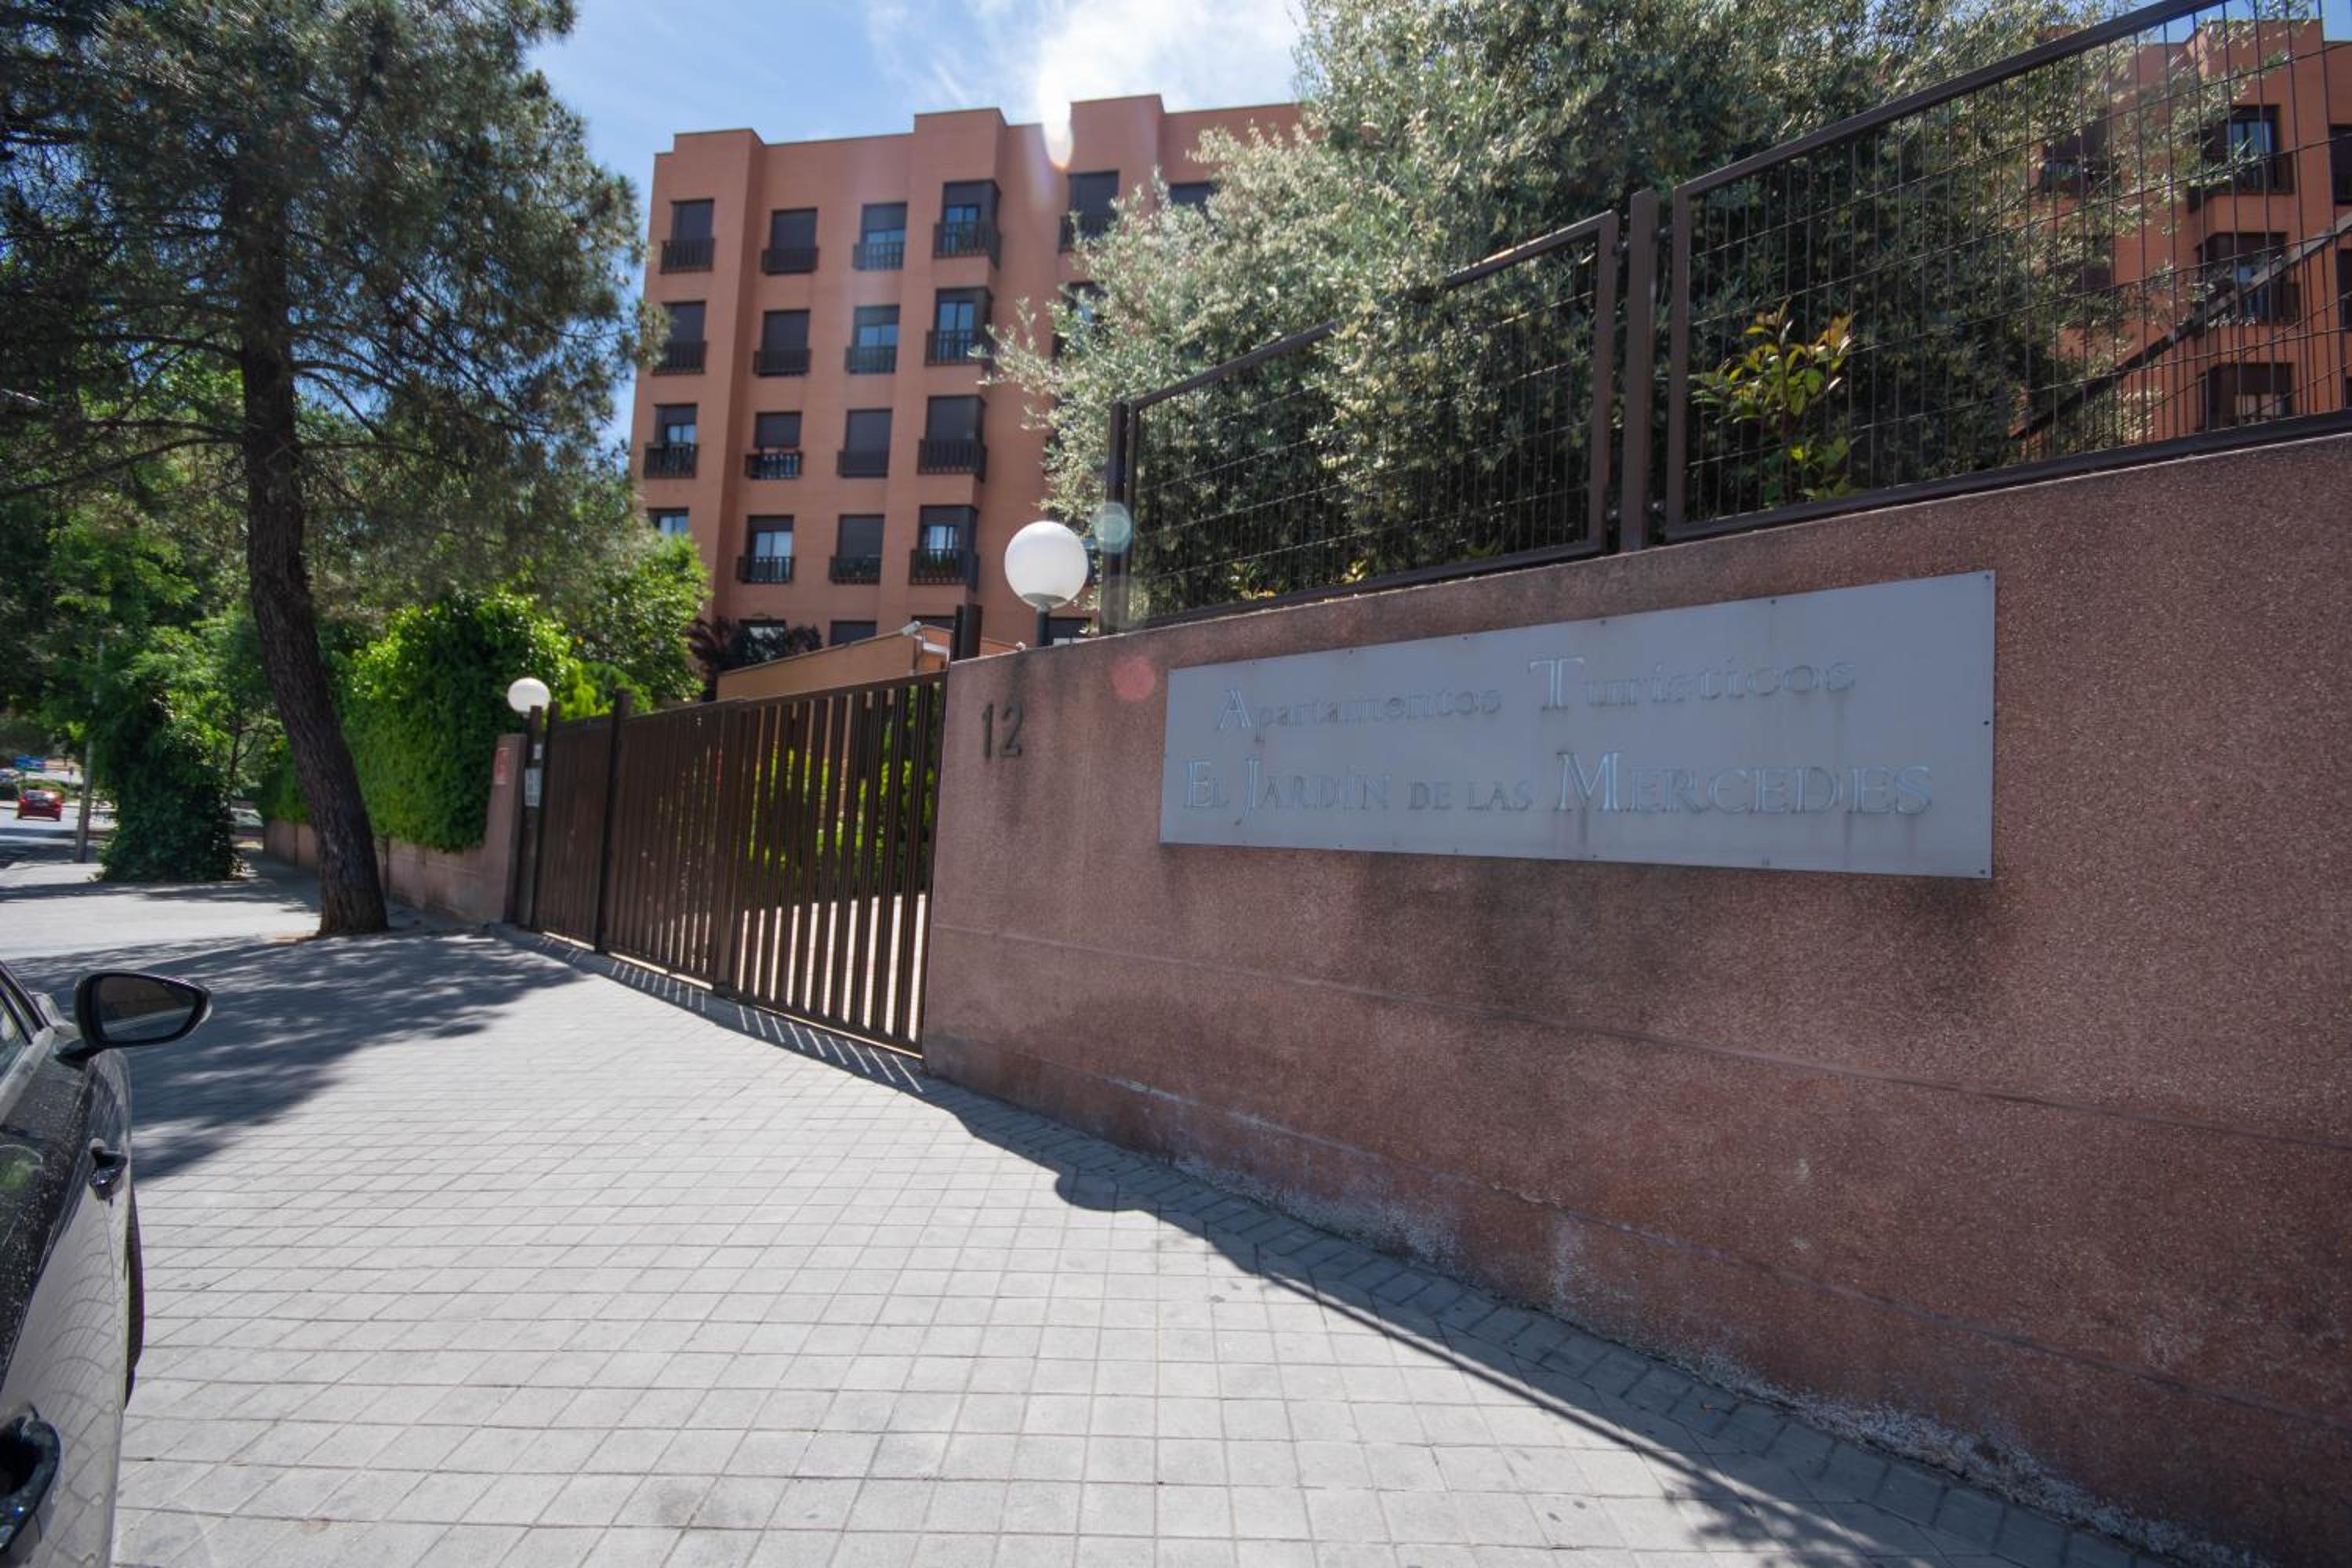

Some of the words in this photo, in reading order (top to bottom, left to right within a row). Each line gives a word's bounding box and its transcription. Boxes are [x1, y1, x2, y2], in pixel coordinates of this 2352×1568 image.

[981, 702, 1024, 760] 12
[1216, 688, 1502, 742] Apartamentos
[1181, 757, 1230, 810] EL
[1234, 755, 1392, 826] JARDÍN
[1407, 778, 1454, 811] DE
[1467, 779, 1534, 813] LAS
[1553, 750, 1933, 816] MERCEDES
